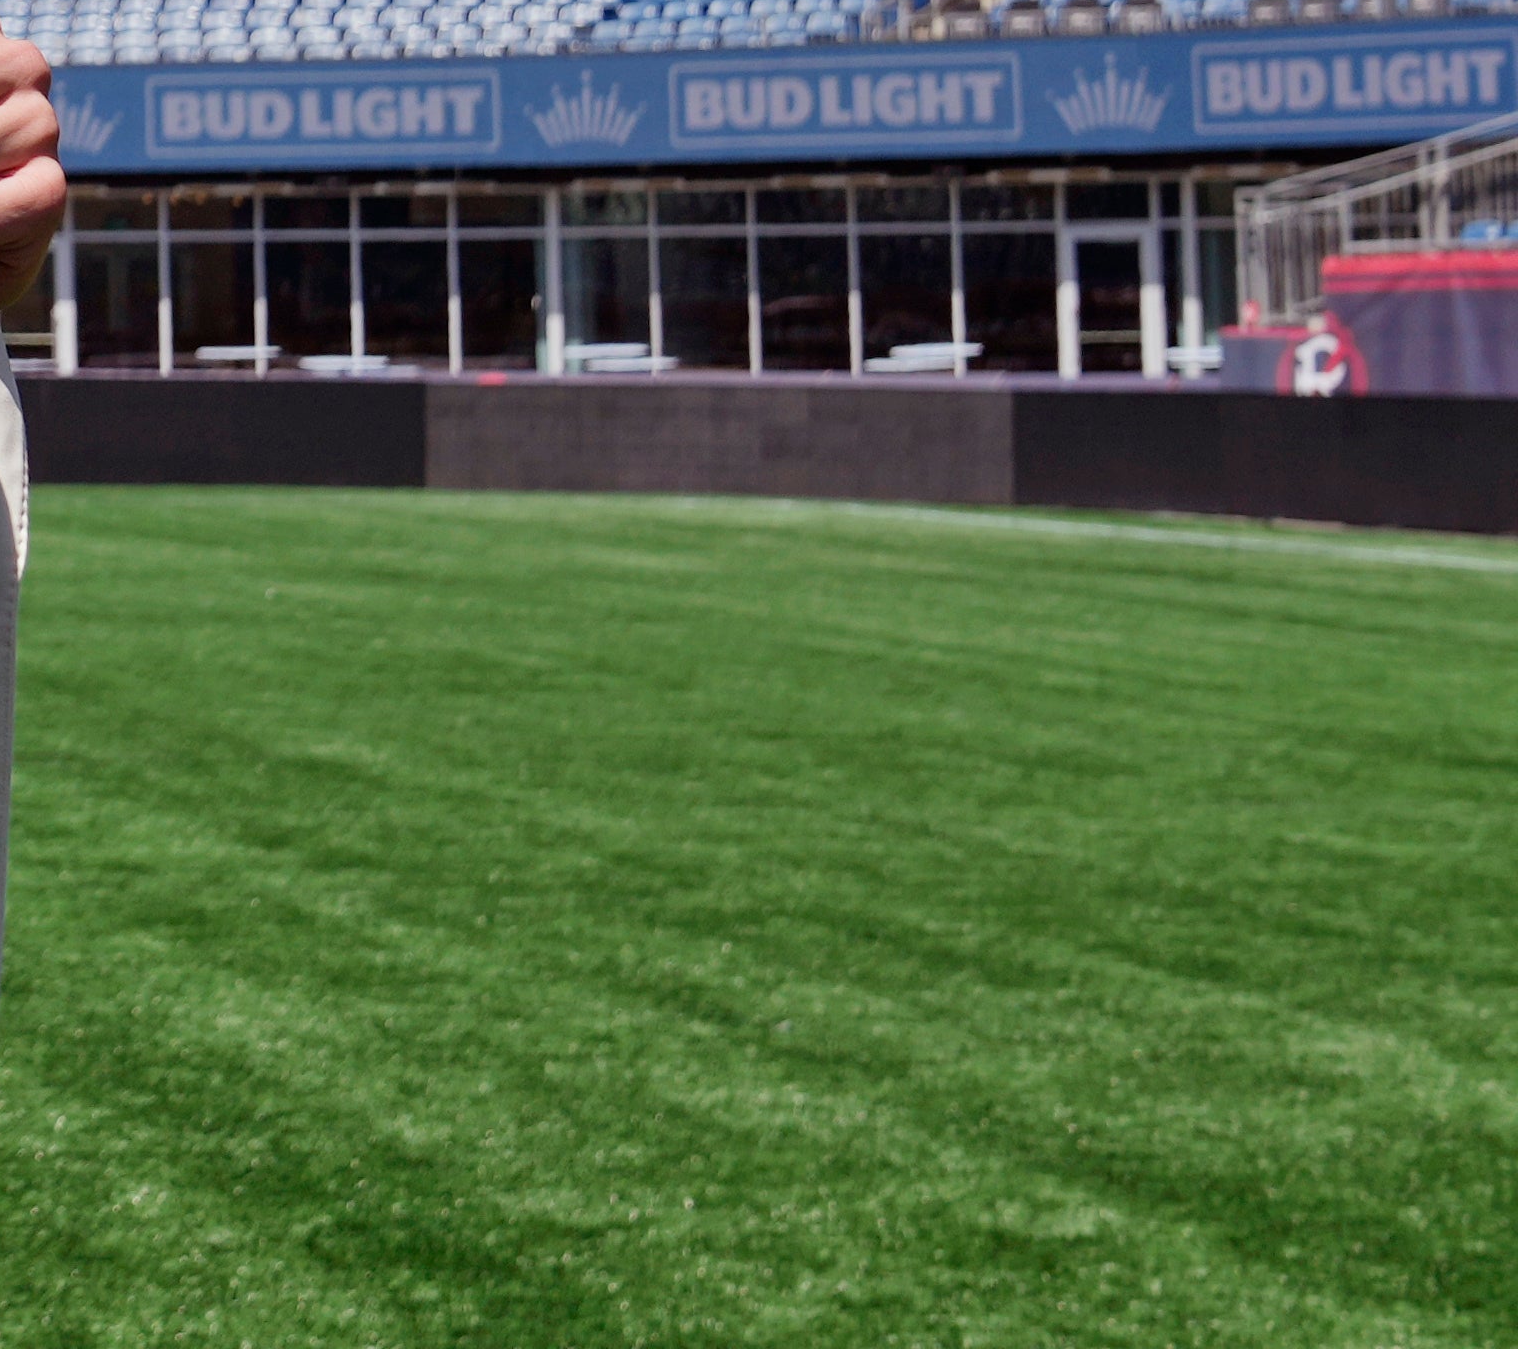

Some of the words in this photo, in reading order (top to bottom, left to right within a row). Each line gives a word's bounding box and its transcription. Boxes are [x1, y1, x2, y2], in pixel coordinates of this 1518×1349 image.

[161, 88, 293, 141] BUD
[300, 82, 486, 138] LIGHT
[683, 77, 813, 131] BUD
[820, 70, 1008, 128] LIGHT
[1206, 57, 1334, 114] BUD
[1341, 48, 1508, 109] LIGHT
